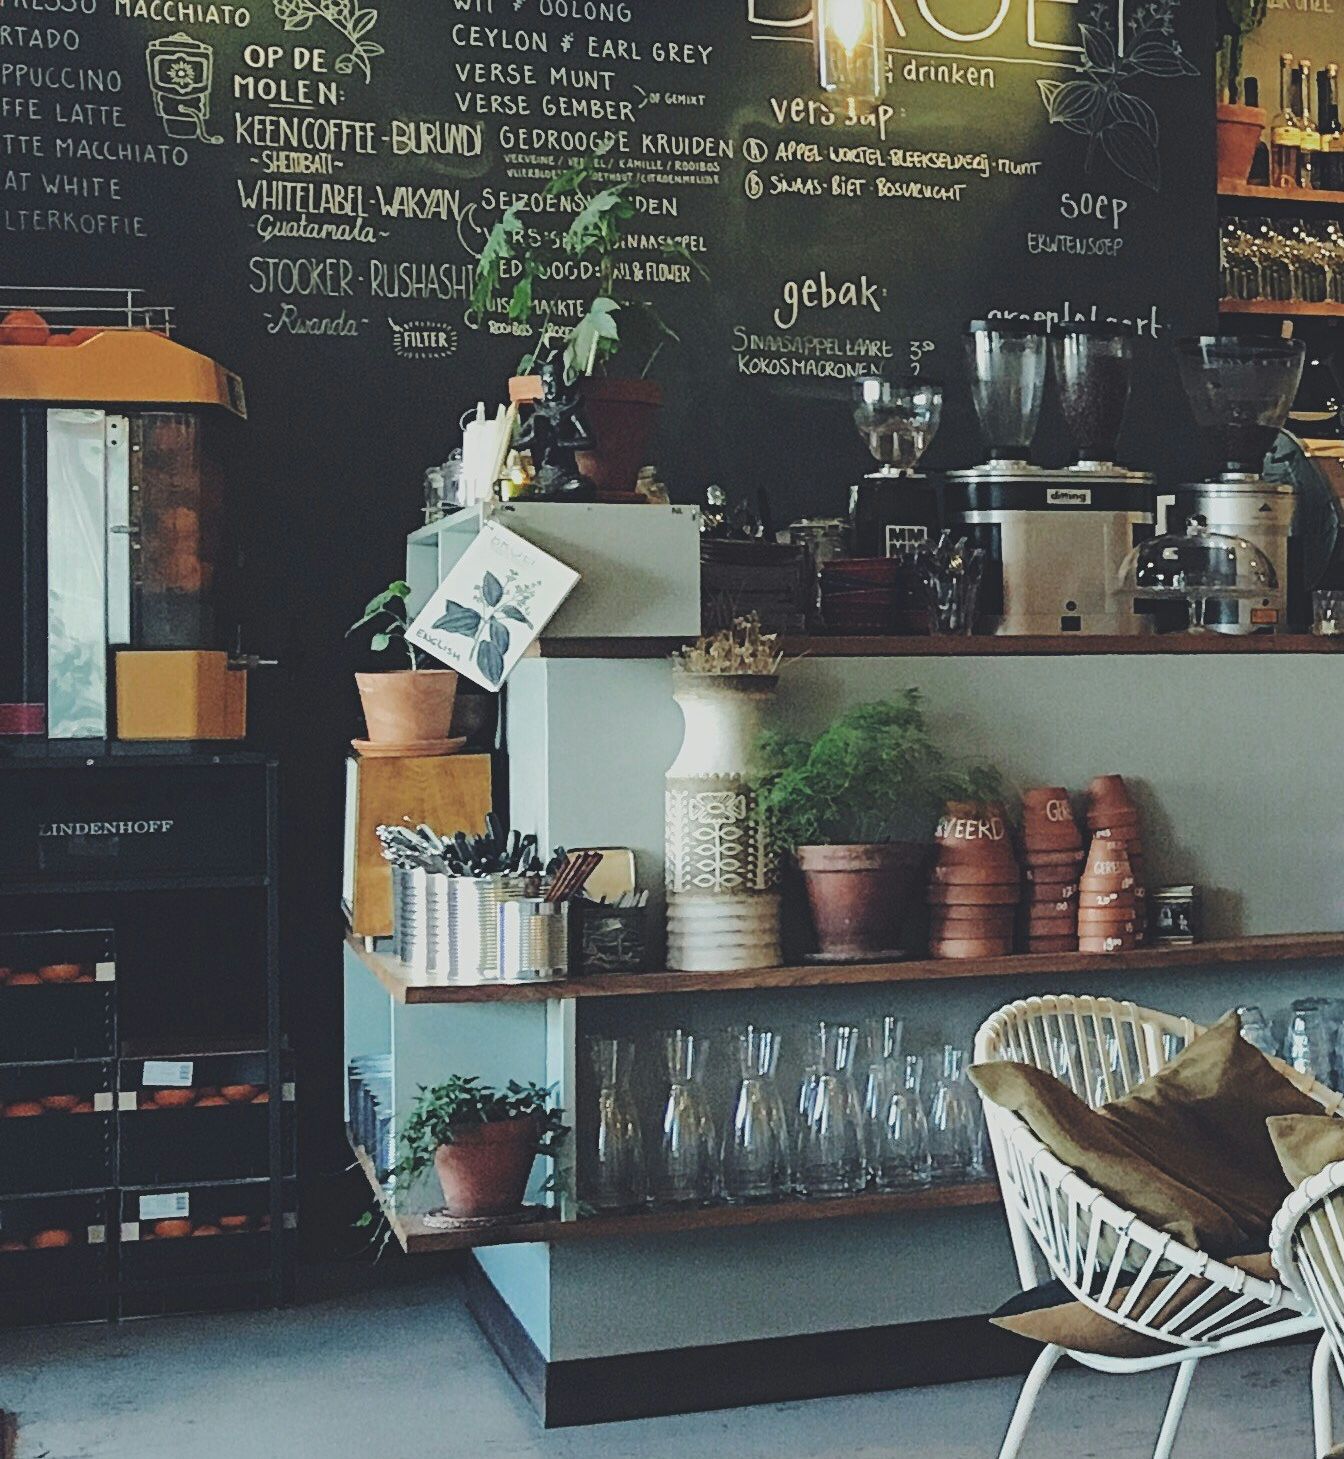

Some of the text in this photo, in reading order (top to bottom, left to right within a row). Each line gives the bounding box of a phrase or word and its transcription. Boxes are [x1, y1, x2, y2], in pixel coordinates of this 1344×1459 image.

[115, 0, 250, 28] MACCHIATO
[540, 0, 632, 23] OOLONG
[0, 25, 79, 50] RTADO
[452, 24, 548, 53] CEYLON
[588, 36, 641, 60] EARL
[652, 42, 713, 65] GREY
[243, 45, 328, 72] OP DE
[2, 63, 122, 92] PPUCCINO
[455, 63, 616, 91] VERSE MUNT
[903, 59, 995, 88] drinken
[2, 97, 126, 127] FFE LATTE
[455, 92, 636, 122] VERSE GEMBER
[3, 134, 188, 166] TTE MACCHIATO
[642, 133, 734, 159] KRUIDEN
[775, 141, 823, 162] APPEL
[4, 170, 122, 200] AT WHITE
[5, 210, 148, 237] LTERKOFFIE
[404, 331, 449, 349] FILTER
[415, 627, 462, 662] ENGLISH
[38, 820, 174, 837] LINDENHOFF
